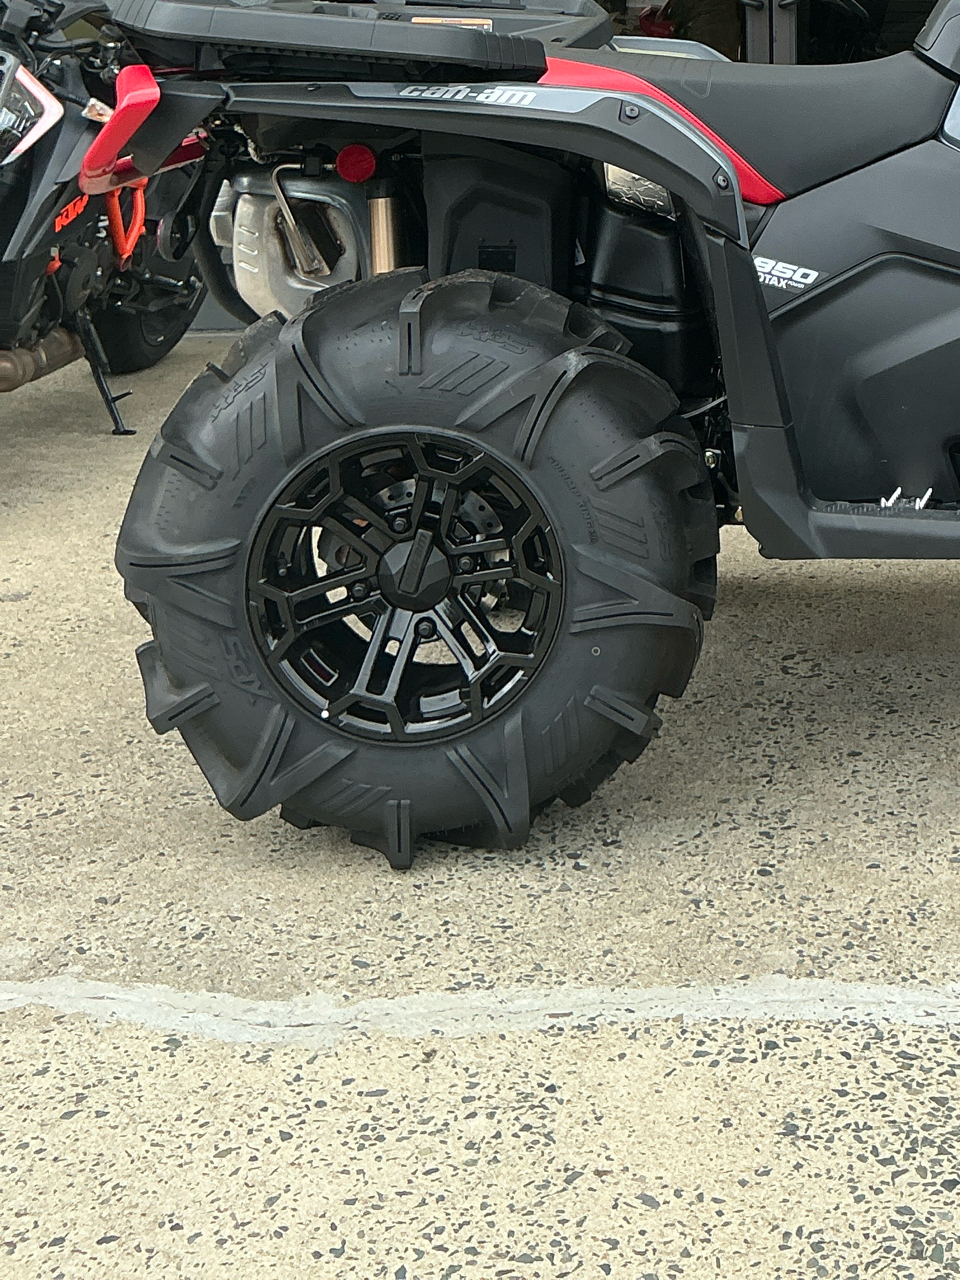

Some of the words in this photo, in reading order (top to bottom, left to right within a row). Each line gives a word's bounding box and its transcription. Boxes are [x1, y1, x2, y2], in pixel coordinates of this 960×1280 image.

[400, 85, 538, 106] can-am
[54, 193, 90, 233] KTM
[753, 256, 819, 285] 850
